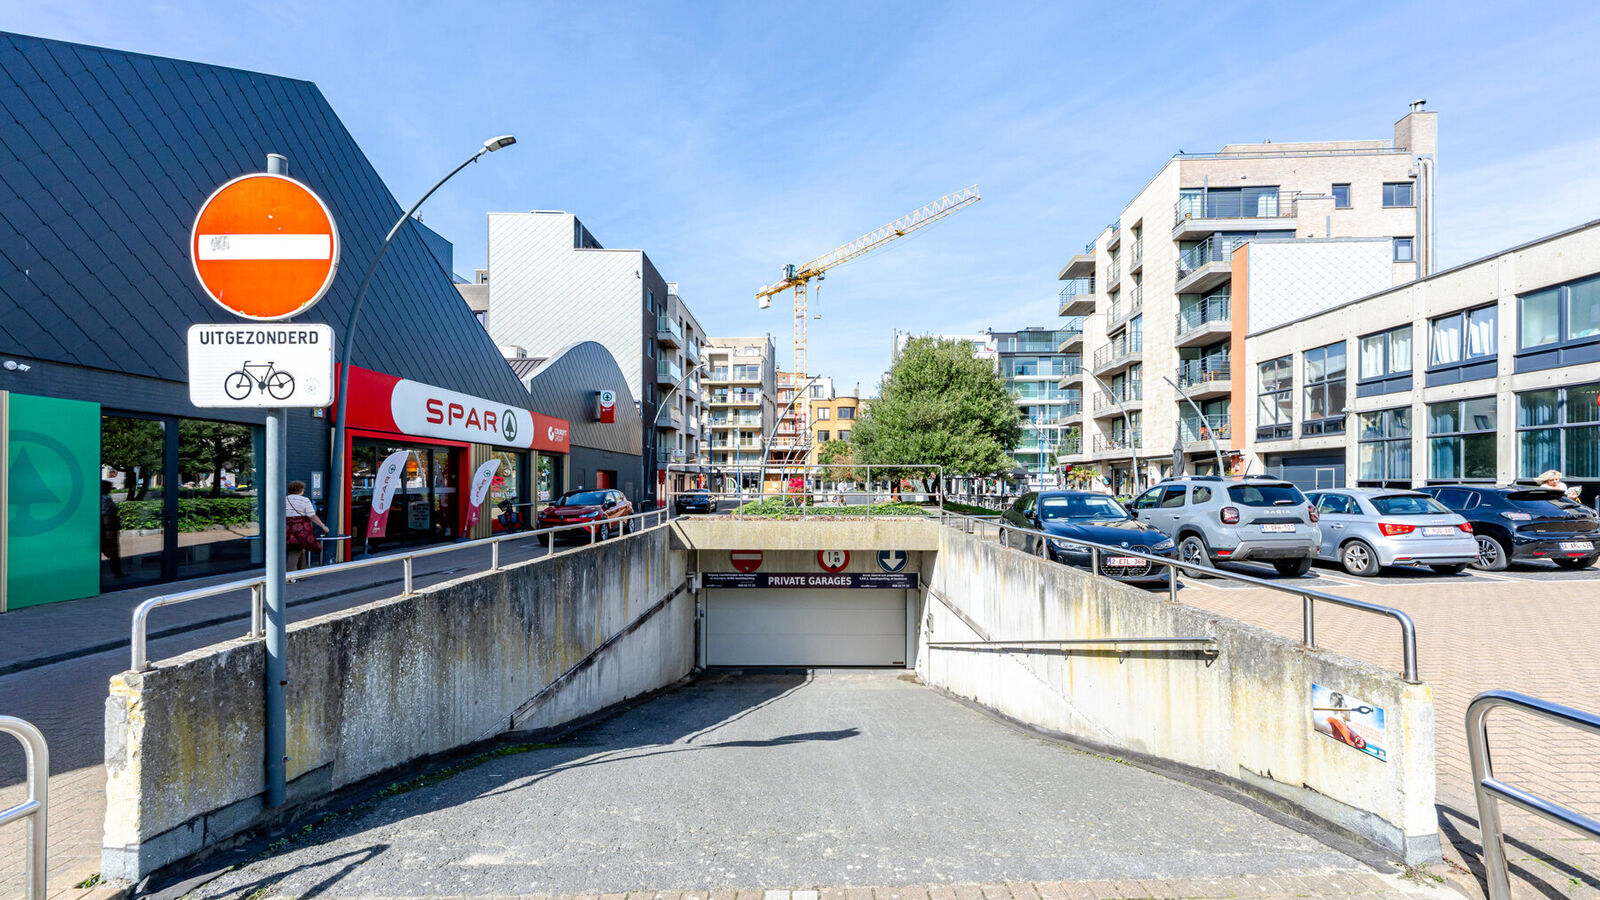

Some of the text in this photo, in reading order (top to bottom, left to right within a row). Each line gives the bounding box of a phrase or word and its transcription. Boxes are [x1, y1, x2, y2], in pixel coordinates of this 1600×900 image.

[200, 331, 319, 344] UITGEZONDERD
[426, 398, 498, 433] SPAR
[379, 476, 390, 510] SPAR
[768, 576, 806, 585] PRIVATE
[808, 576, 852, 585] GARAGES
